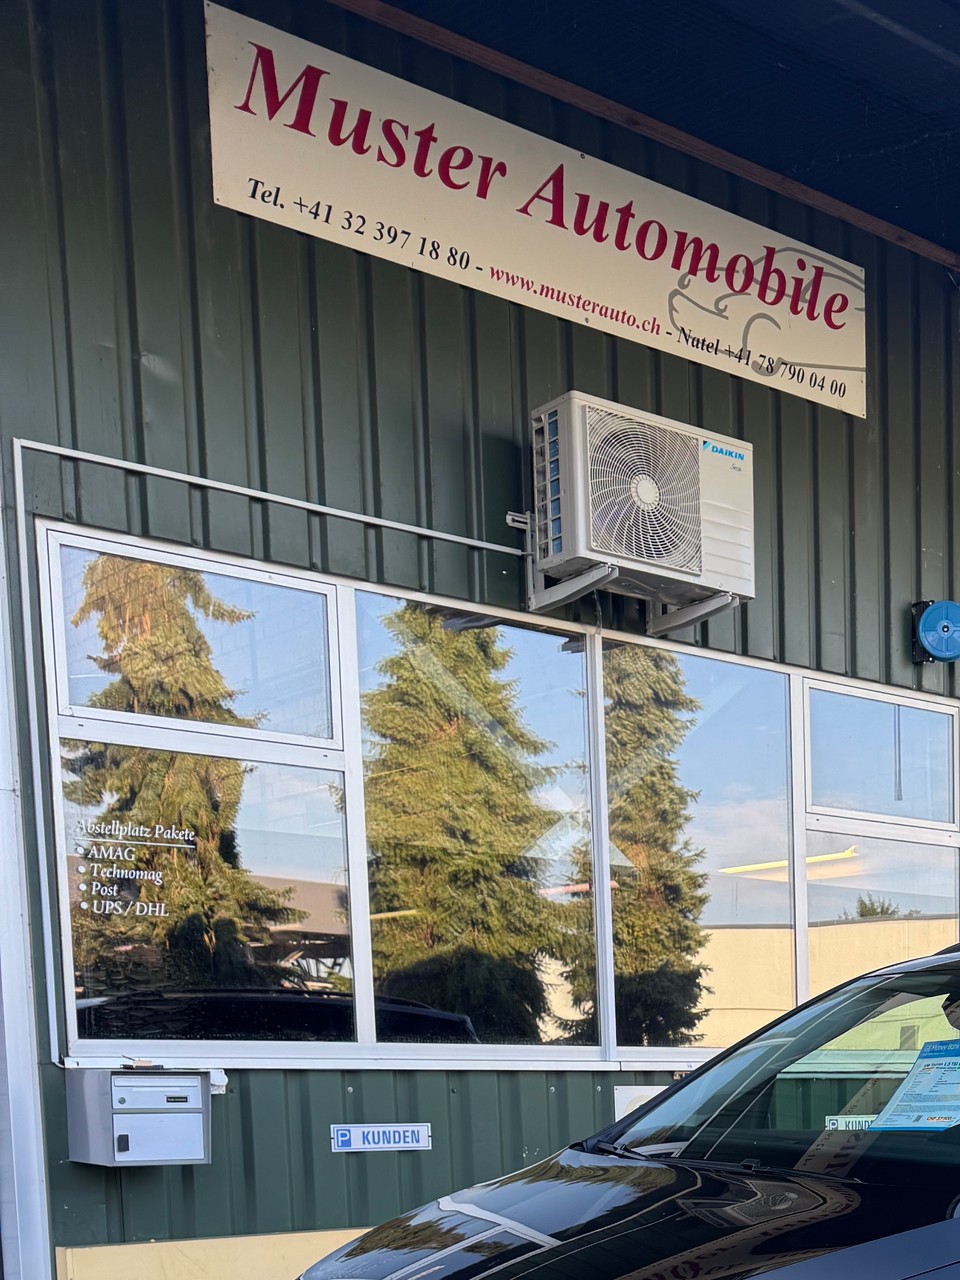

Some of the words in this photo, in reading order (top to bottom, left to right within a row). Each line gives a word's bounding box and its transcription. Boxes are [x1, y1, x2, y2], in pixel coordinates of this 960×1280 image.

[234, 41, 507, 200] Muster
[515, 163, 849, 331] Automobile
[248, 177, 285, 209] Tel.
[293, 197, 333, 225] +41
[341, 210, 366, 235] 32
[373, 221, 411, 249] 397
[418, 236, 441, 260] 18
[447, 247, 470, 270] 80
[489, 265, 661, 336] www.musterauto.ch
[677, 326, 720, 356] Natel
[724, 344, 751, 366] +41
[758, 354, 774, 374] 78
[780, 361, 805, 384] 790
[809, 372, 825, 391] 04
[830, 379, 846, 398] 00
[711, 445, 745, 461] DAIKIN
[76, 819, 150, 838] Abstellplatz
[154, 824, 195, 841] Pakete
[88, 847, 136, 860] AMAG
[91, 864, 162, 885] Technomag
[91, 882, 118, 896] Post
[93, 900, 122, 915] UPS
[136, 902, 169, 917] DHL
[845, 1120, 873, 1130] KUND
[362, 1129, 420, 1145] KUNDEN
